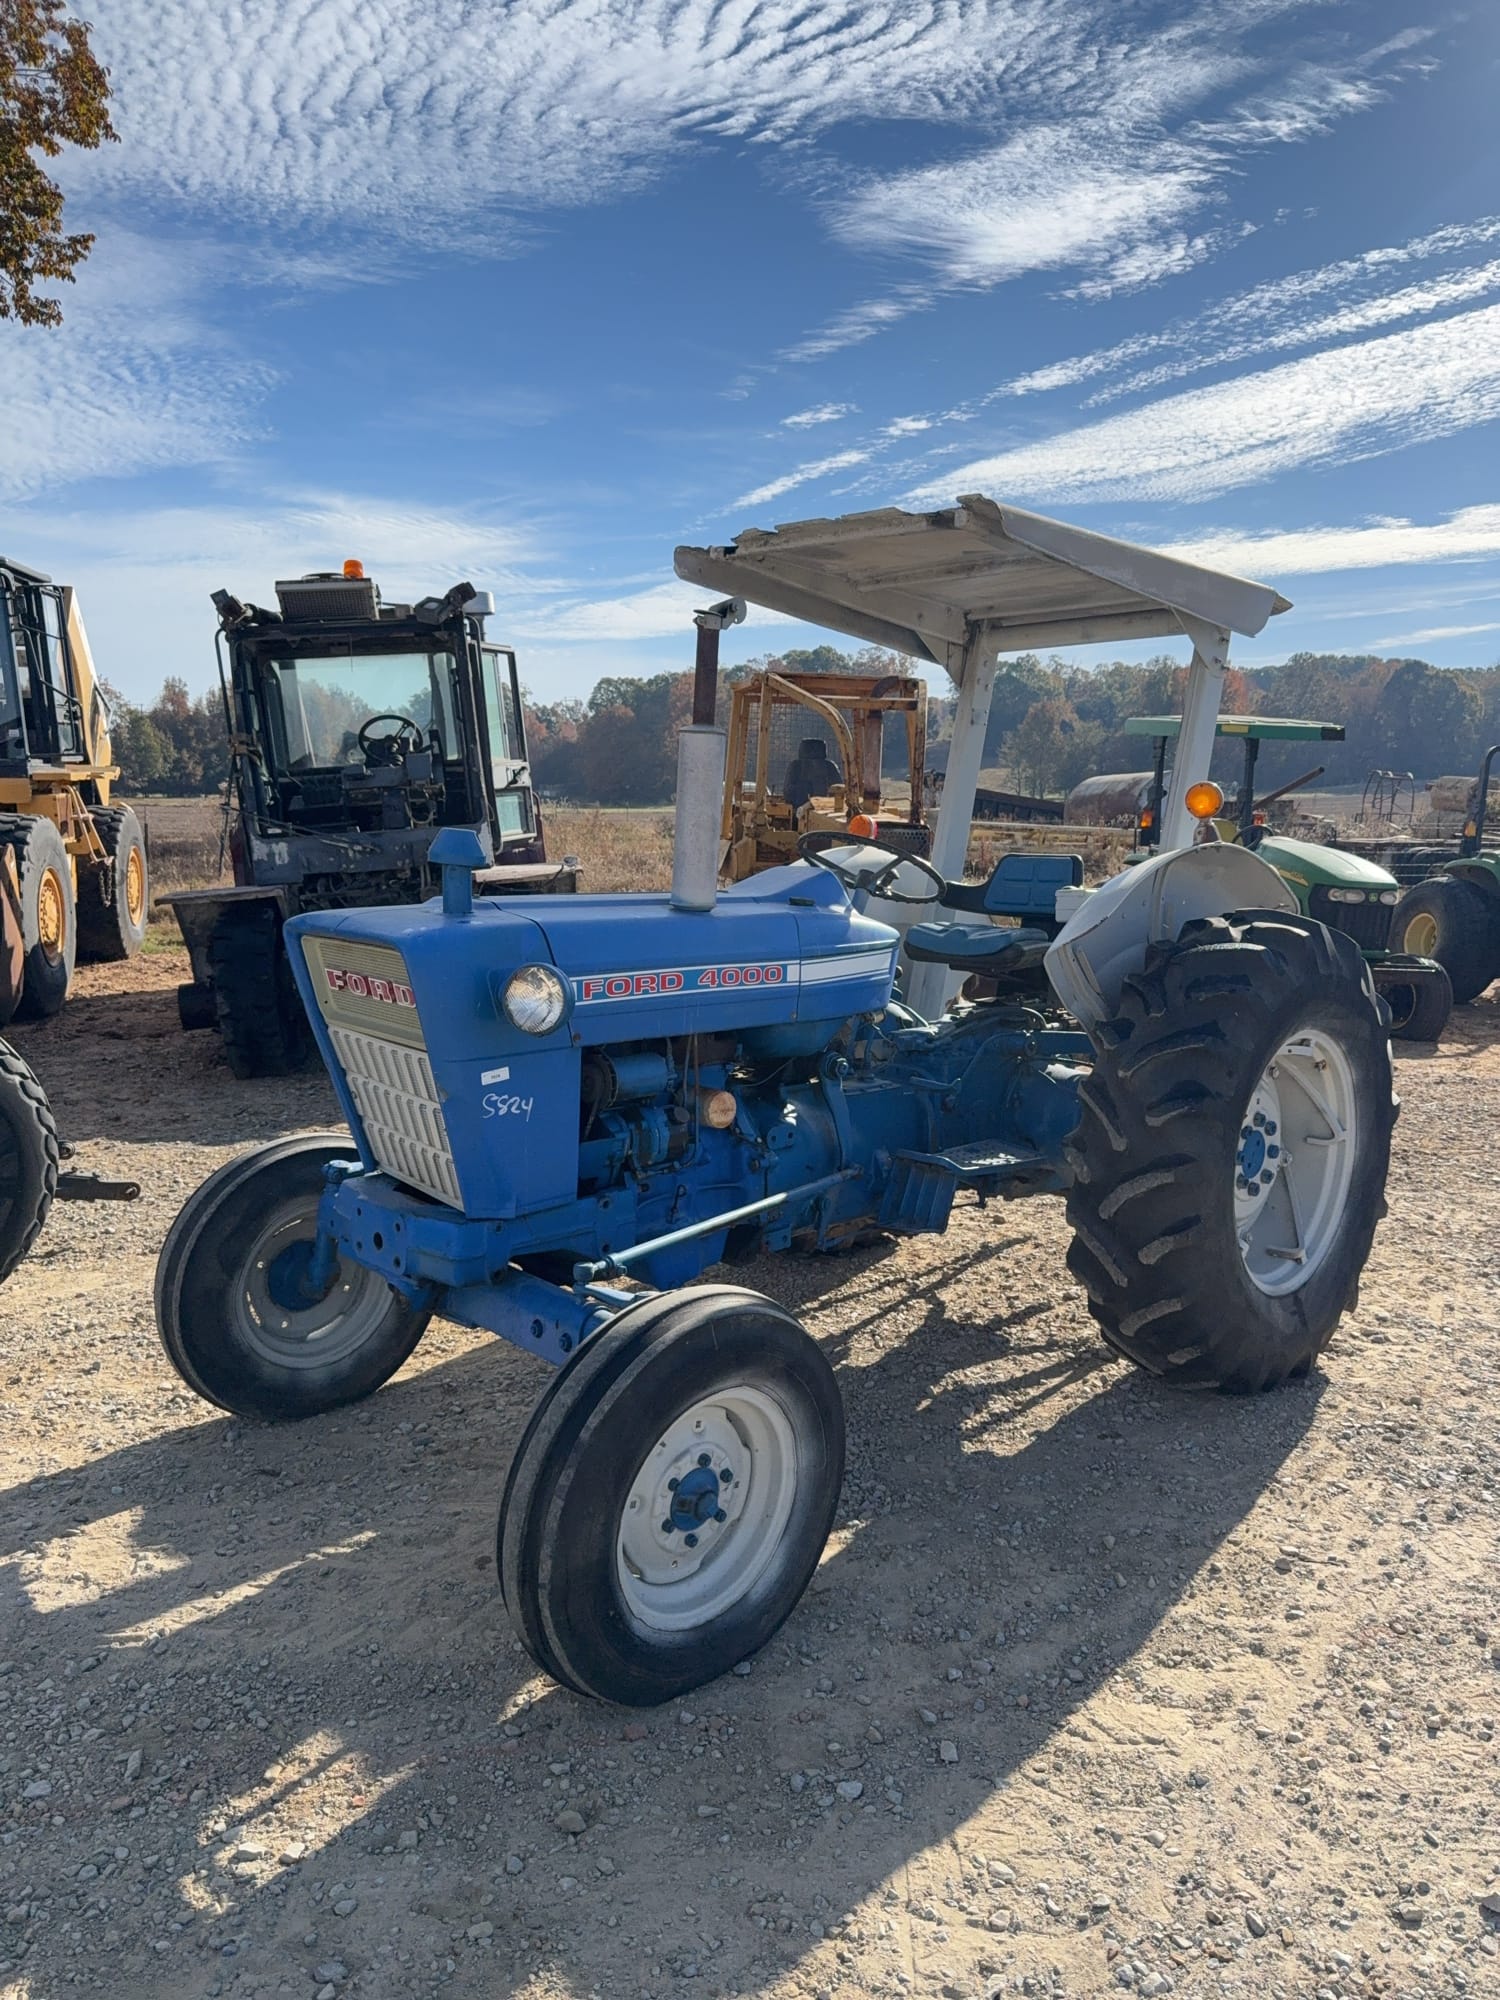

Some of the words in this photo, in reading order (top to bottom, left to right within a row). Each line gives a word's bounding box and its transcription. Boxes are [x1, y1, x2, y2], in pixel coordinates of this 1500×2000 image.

[325, 968, 416, 1008] FORD
[583, 972, 684, 1000] FORD
[698, 965, 784, 988] 4000
